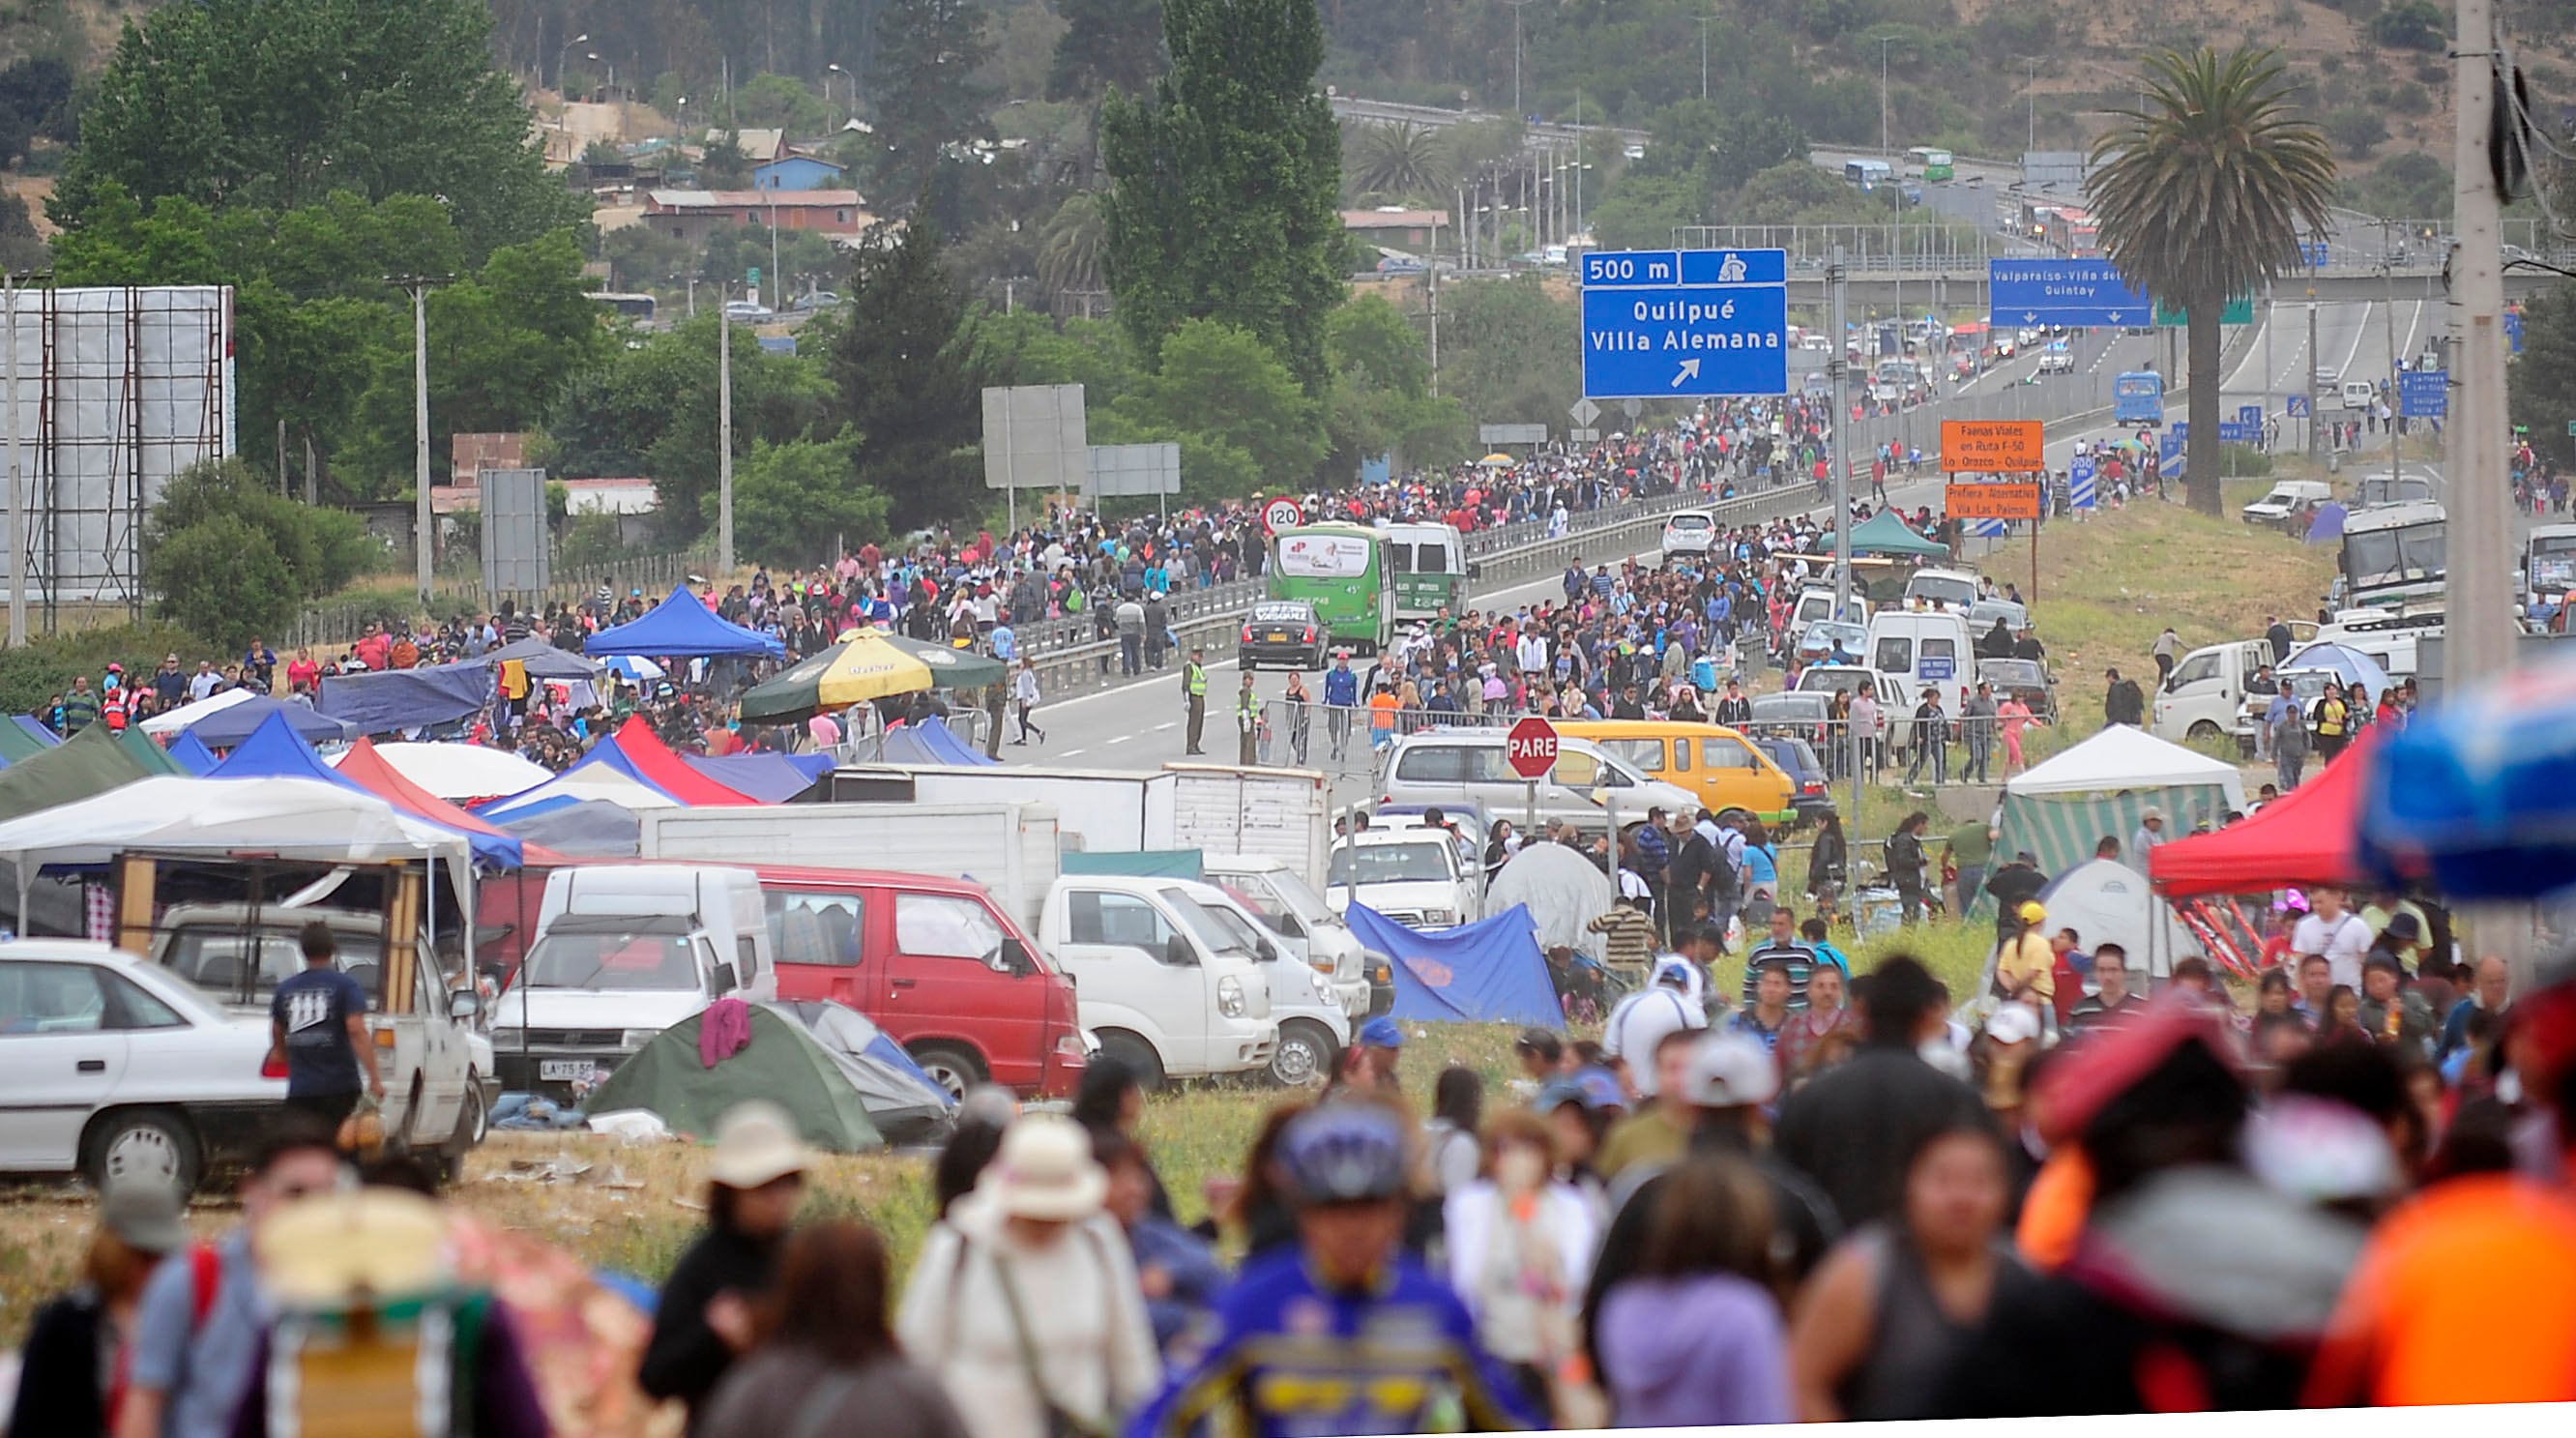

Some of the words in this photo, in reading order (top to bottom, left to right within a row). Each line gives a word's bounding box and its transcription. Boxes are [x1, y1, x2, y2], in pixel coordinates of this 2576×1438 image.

[1590, 259, 1634, 280] 500
[1648, 262, 1670, 279] m
[2045, 285, 2095, 298] Quintay
[1633, 299, 1736, 325] Quilpué
[1591, 331, 1651, 351] Villa
[1662, 330, 1779, 351] Alemana
[1995, 426, 2024, 436] Viales
[2072, 456, 2093, 469] 200
[1269, 509, 1297, 524] 120
[1997, 504, 2028, 514] Palmas
[1508, 737, 1556, 759] PARE
